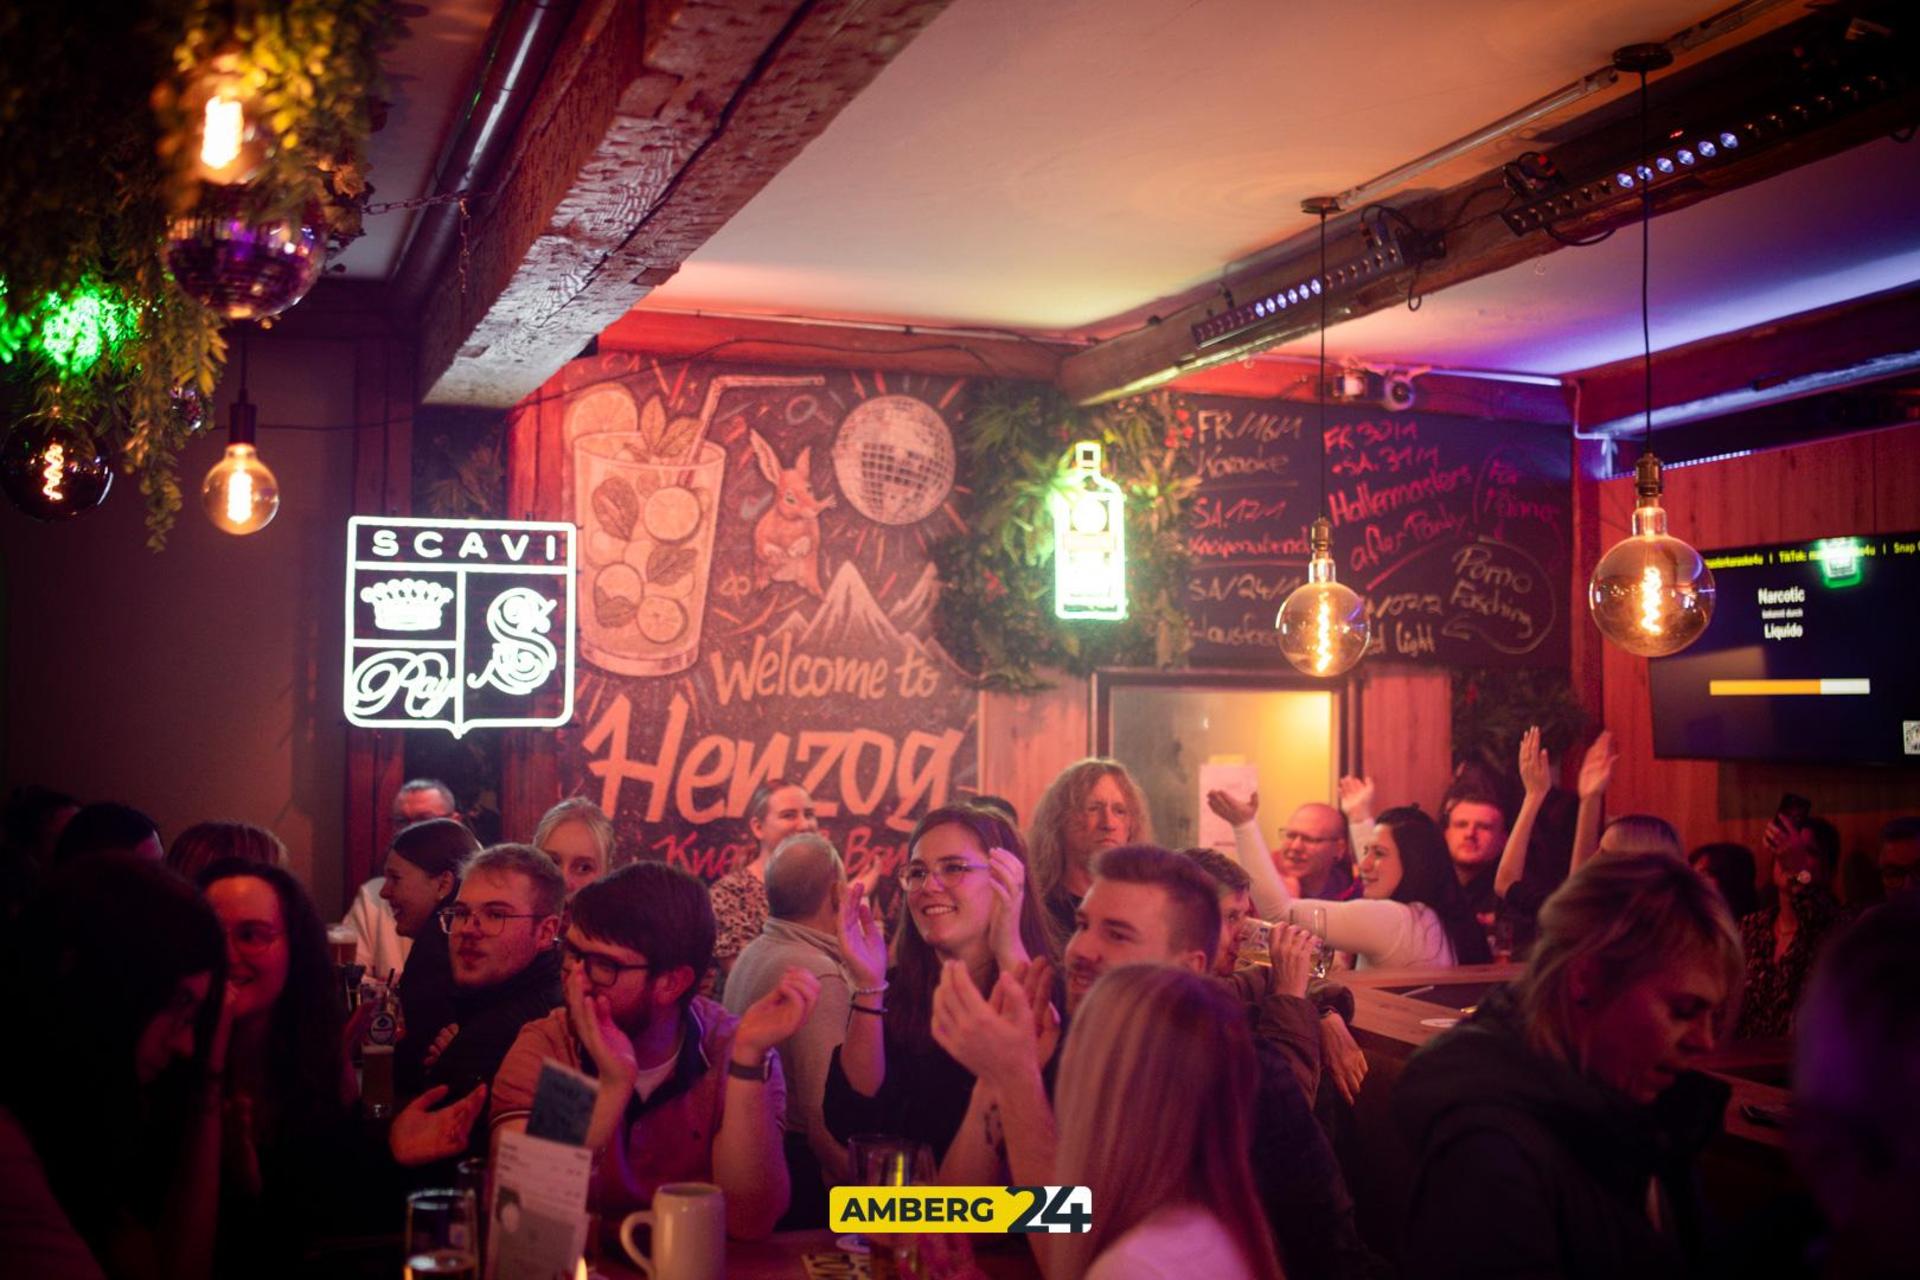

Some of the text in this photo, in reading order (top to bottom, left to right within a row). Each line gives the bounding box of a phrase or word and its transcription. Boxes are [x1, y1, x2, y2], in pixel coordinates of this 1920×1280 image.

[372, 530, 555, 561] SCAVI
[1758, 586, 1806, 605] Narcotic
[1764, 622, 1804, 641] Liquido
[709, 631, 942, 705] Welcome to
[582, 693, 964, 833] Herzog
